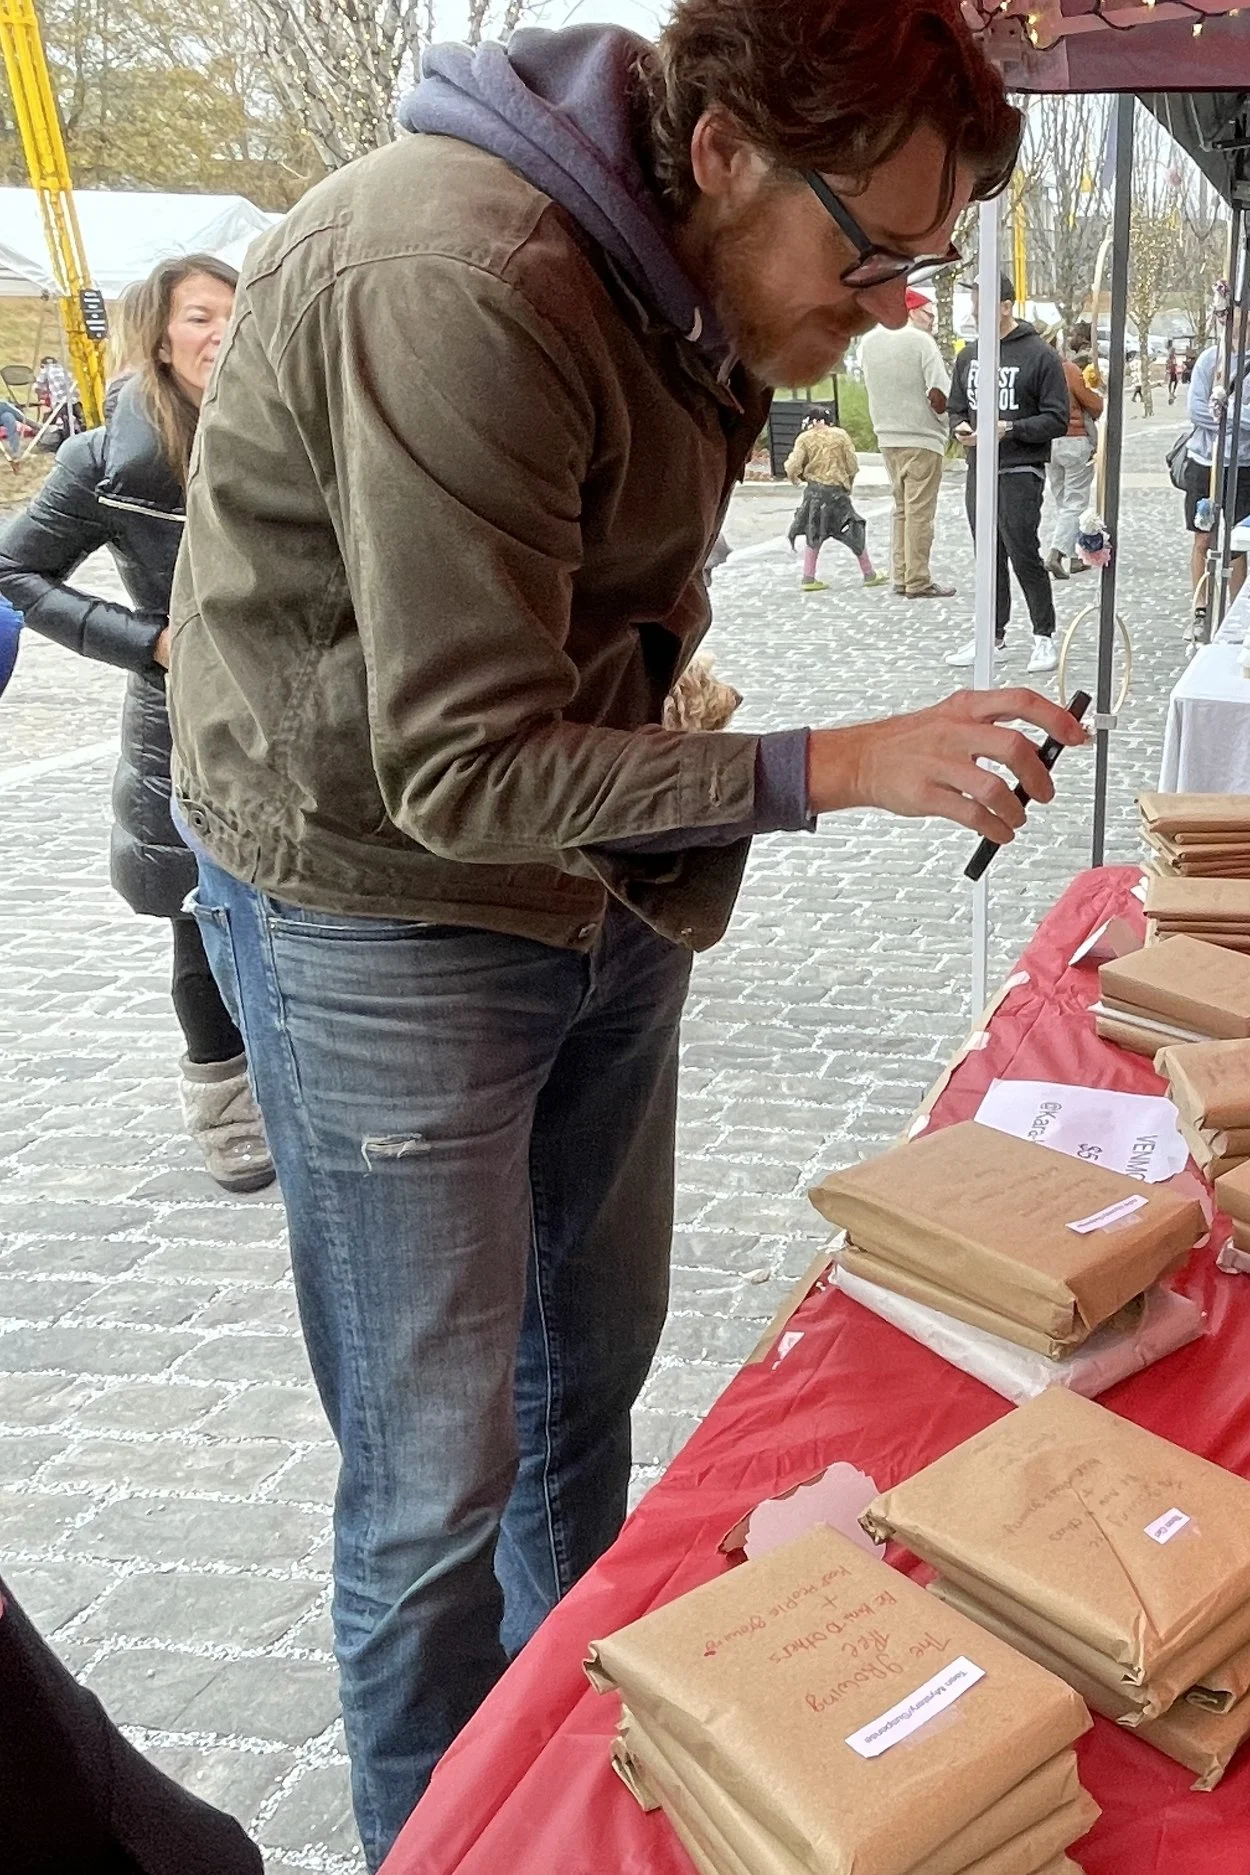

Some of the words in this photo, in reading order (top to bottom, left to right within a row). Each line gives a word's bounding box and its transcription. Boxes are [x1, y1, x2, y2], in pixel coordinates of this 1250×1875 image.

[968, 366, 1020, 388] FST
[967, 388, 1020, 411] SOL
[1078, 1143, 1102, 1161] $5
[909, 1631, 952, 1658] The
[943, 1669, 969, 1688] Teen
